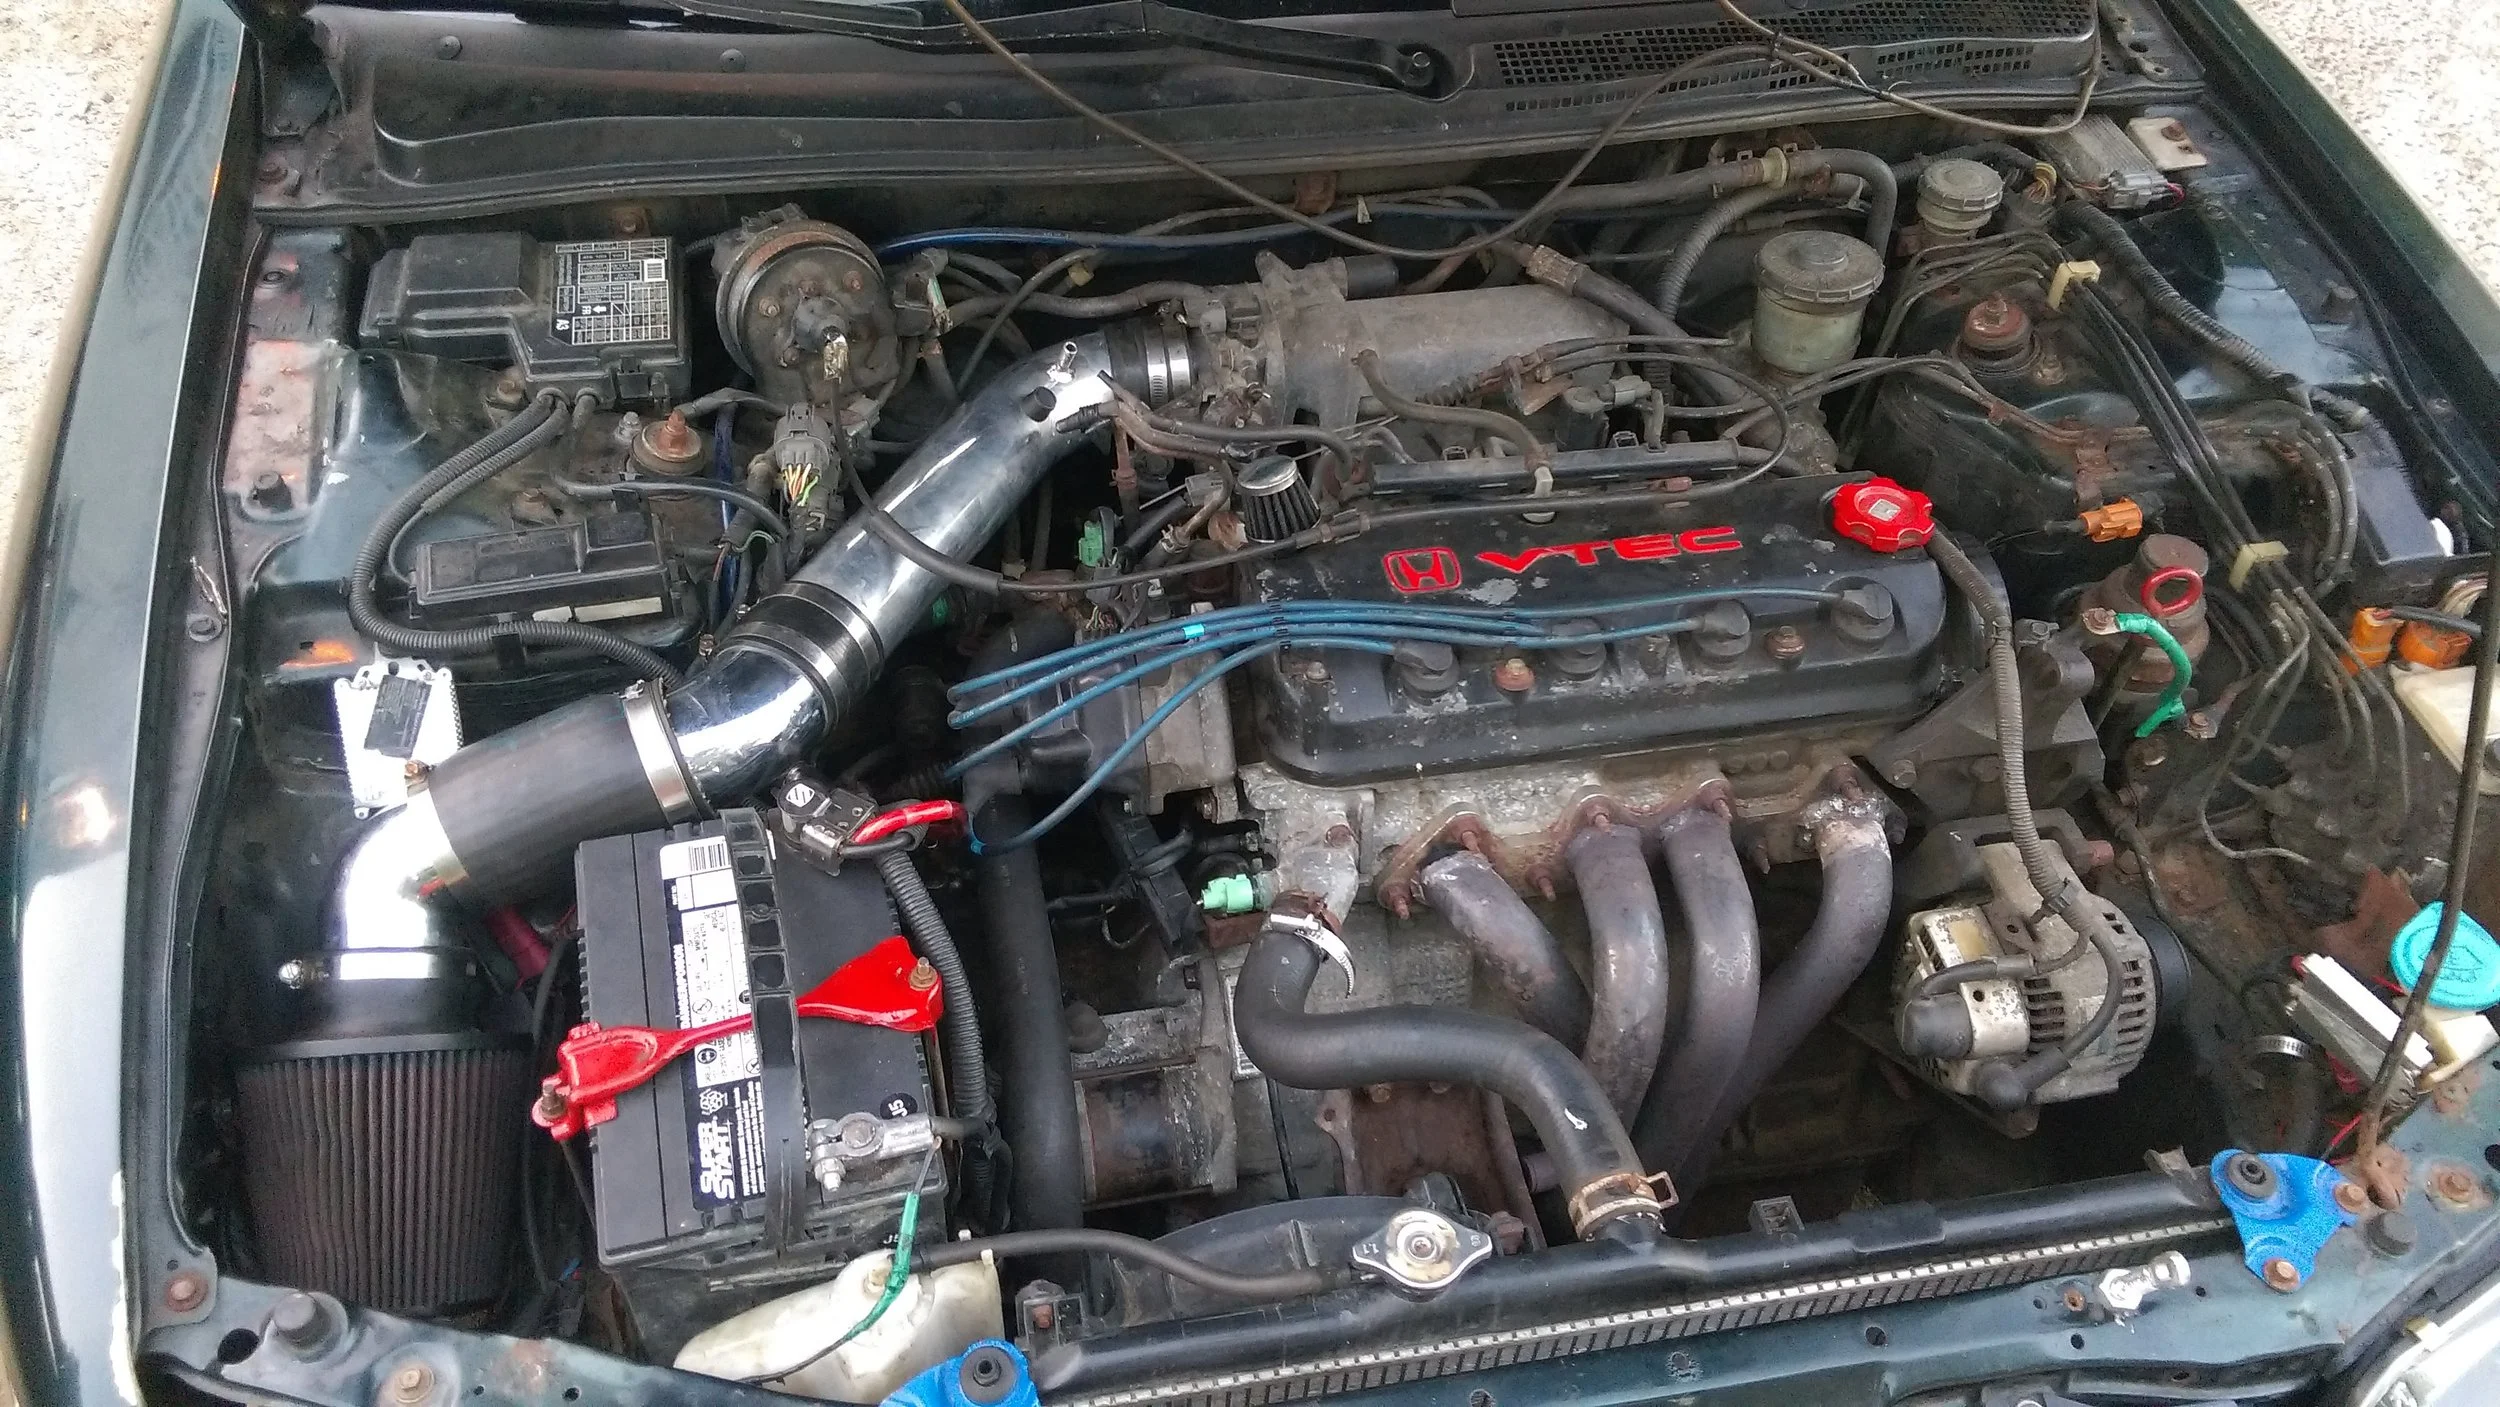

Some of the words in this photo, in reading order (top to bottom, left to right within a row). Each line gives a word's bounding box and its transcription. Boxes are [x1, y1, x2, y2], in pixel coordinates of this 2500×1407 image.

[556, 319, 570, 331] A3
[1476, 526, 1743, 574] VTEC
[698, 1122, 714, 1193] SUPER
[711, 1119, 735, 1199] START
